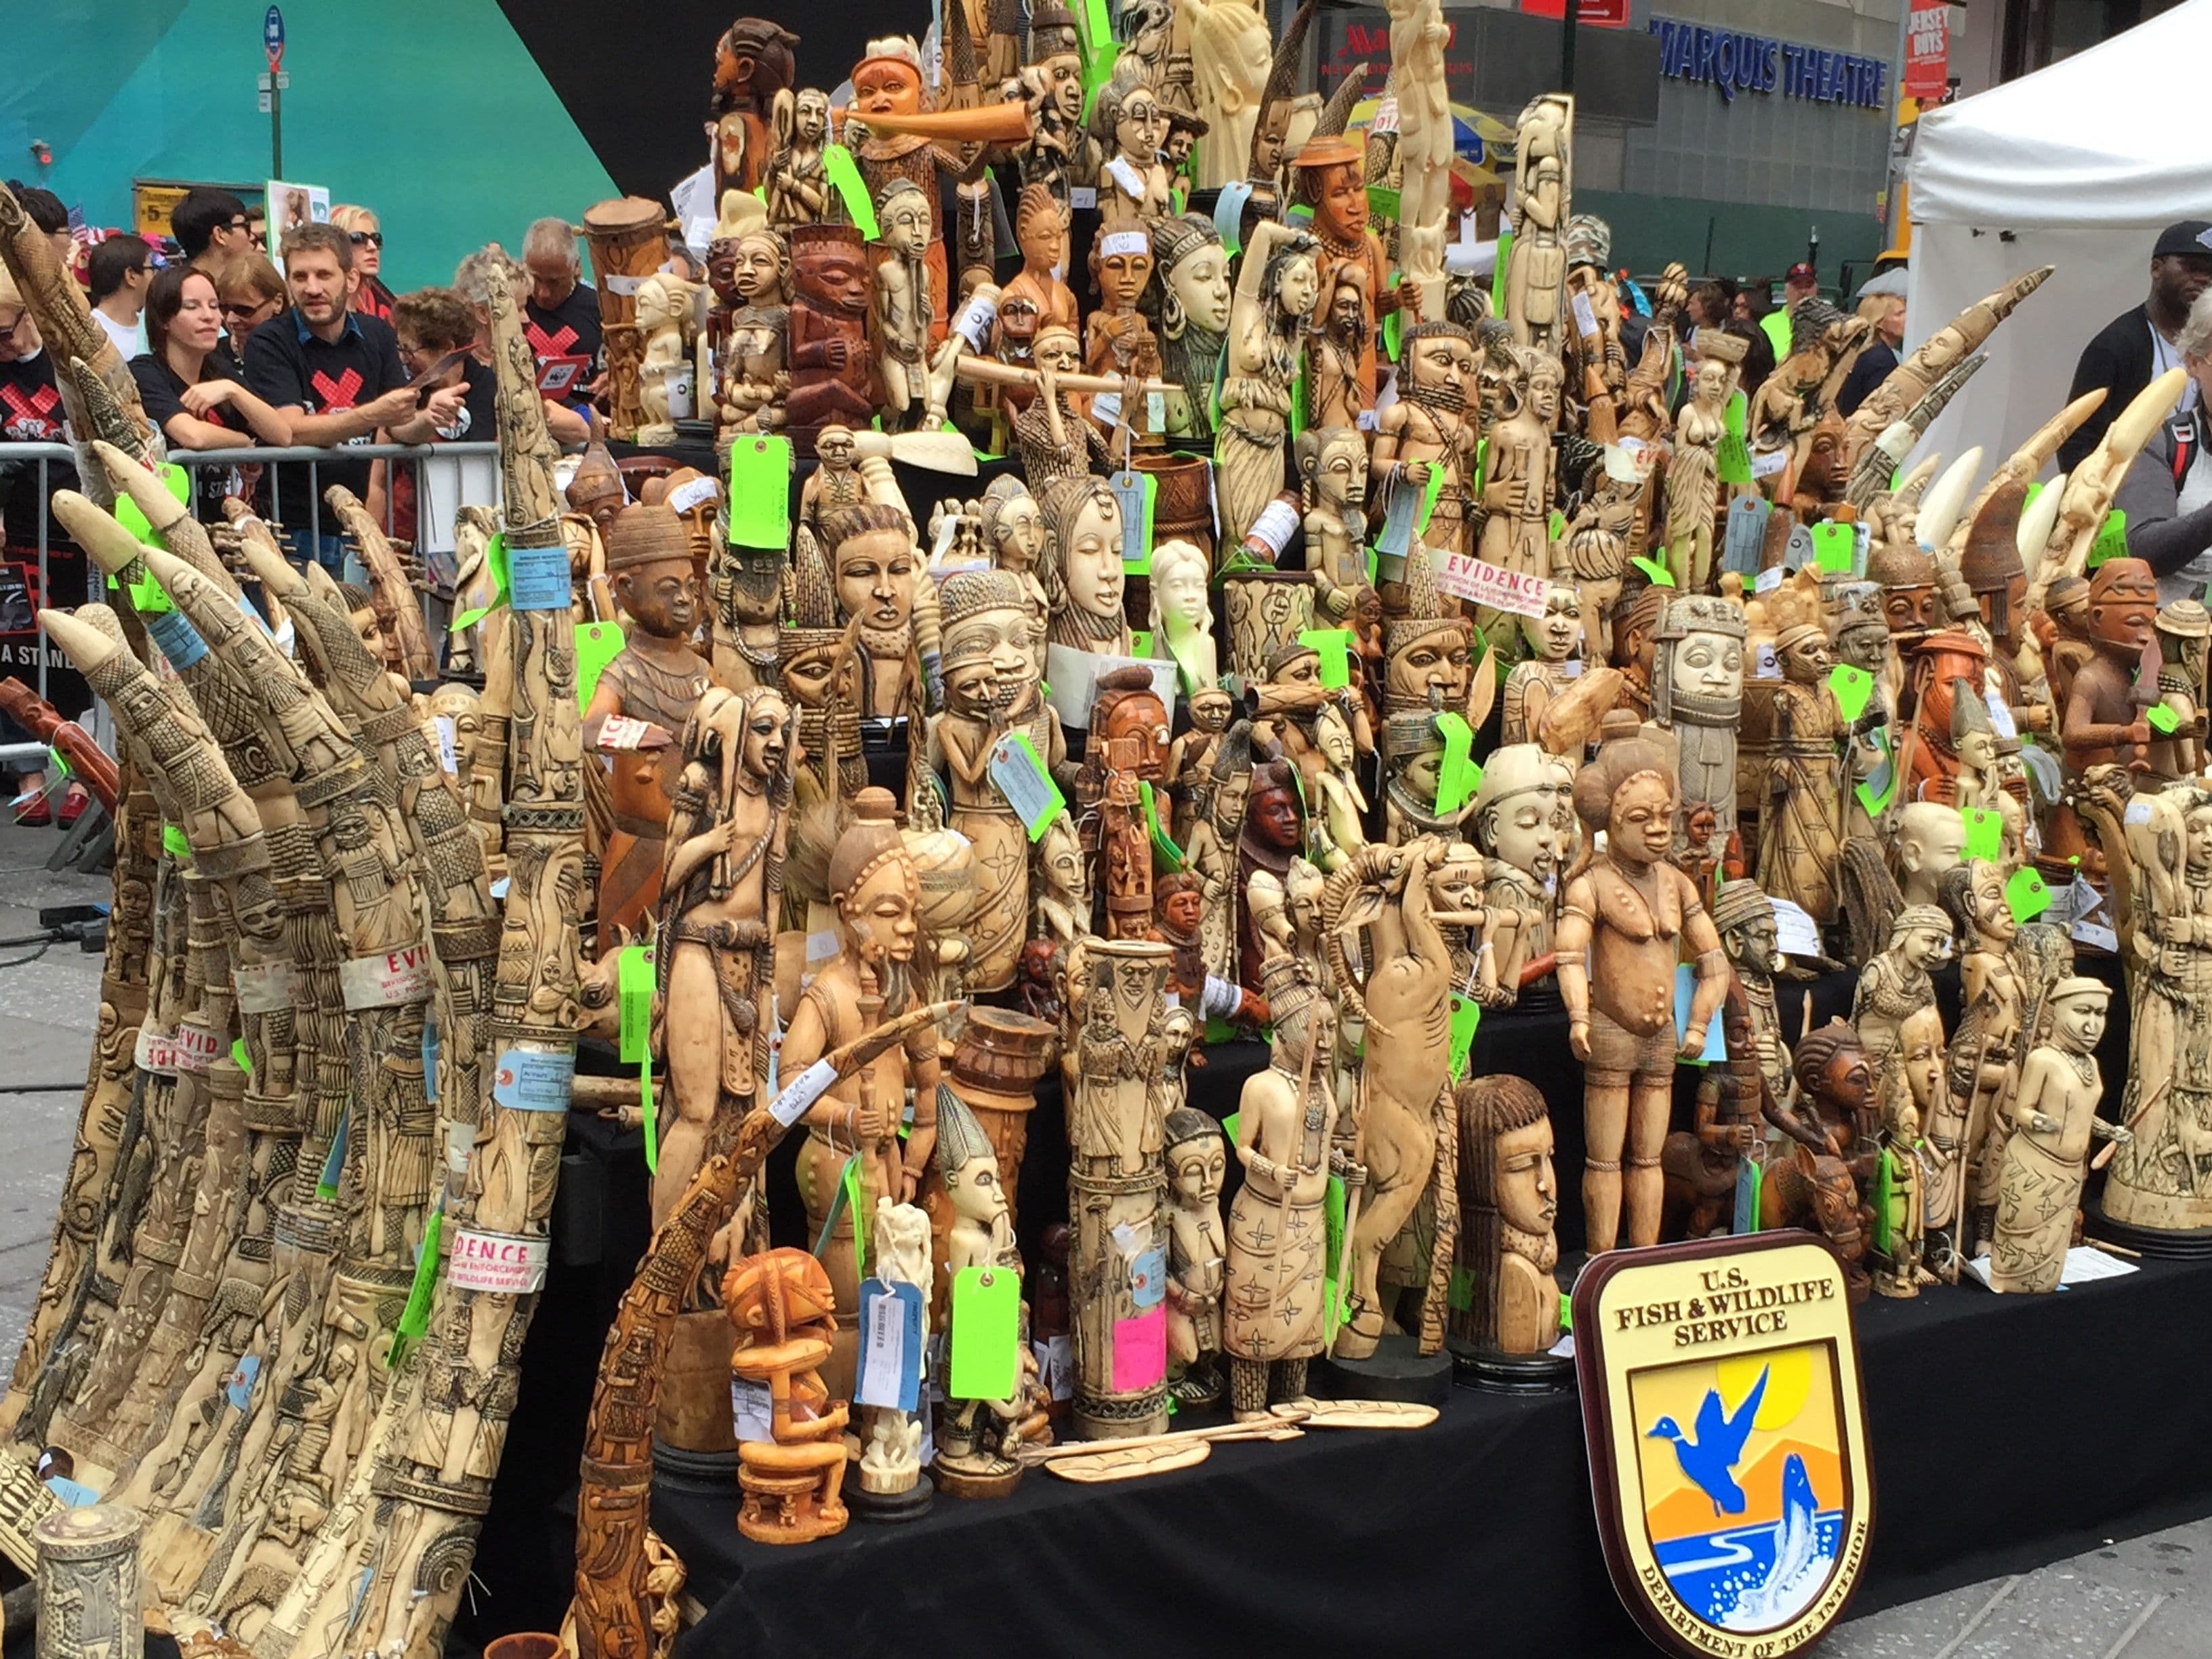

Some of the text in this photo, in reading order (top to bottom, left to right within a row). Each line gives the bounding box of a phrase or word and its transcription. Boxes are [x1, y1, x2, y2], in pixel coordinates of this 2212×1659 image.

[1908, 5, 1950, 35] JERSEY
[1913, 29, 1944, 56] BOYS
[1650, 19, 1888, 108] MARQUIS THEATRE
[1448, 554, 1544, 596] EVIDENCE
[1, 644, 13, 663] A
[1700, 1267, 1749, 1292] U.S.
[1616, 1277, 1835, 1332] FISH & WILDLIFE
[1674, 1309, 1788, 1347] SERVICE
[1641, 1520, 1867, 1658] DEPARTMENT OF THE INTERIOR
